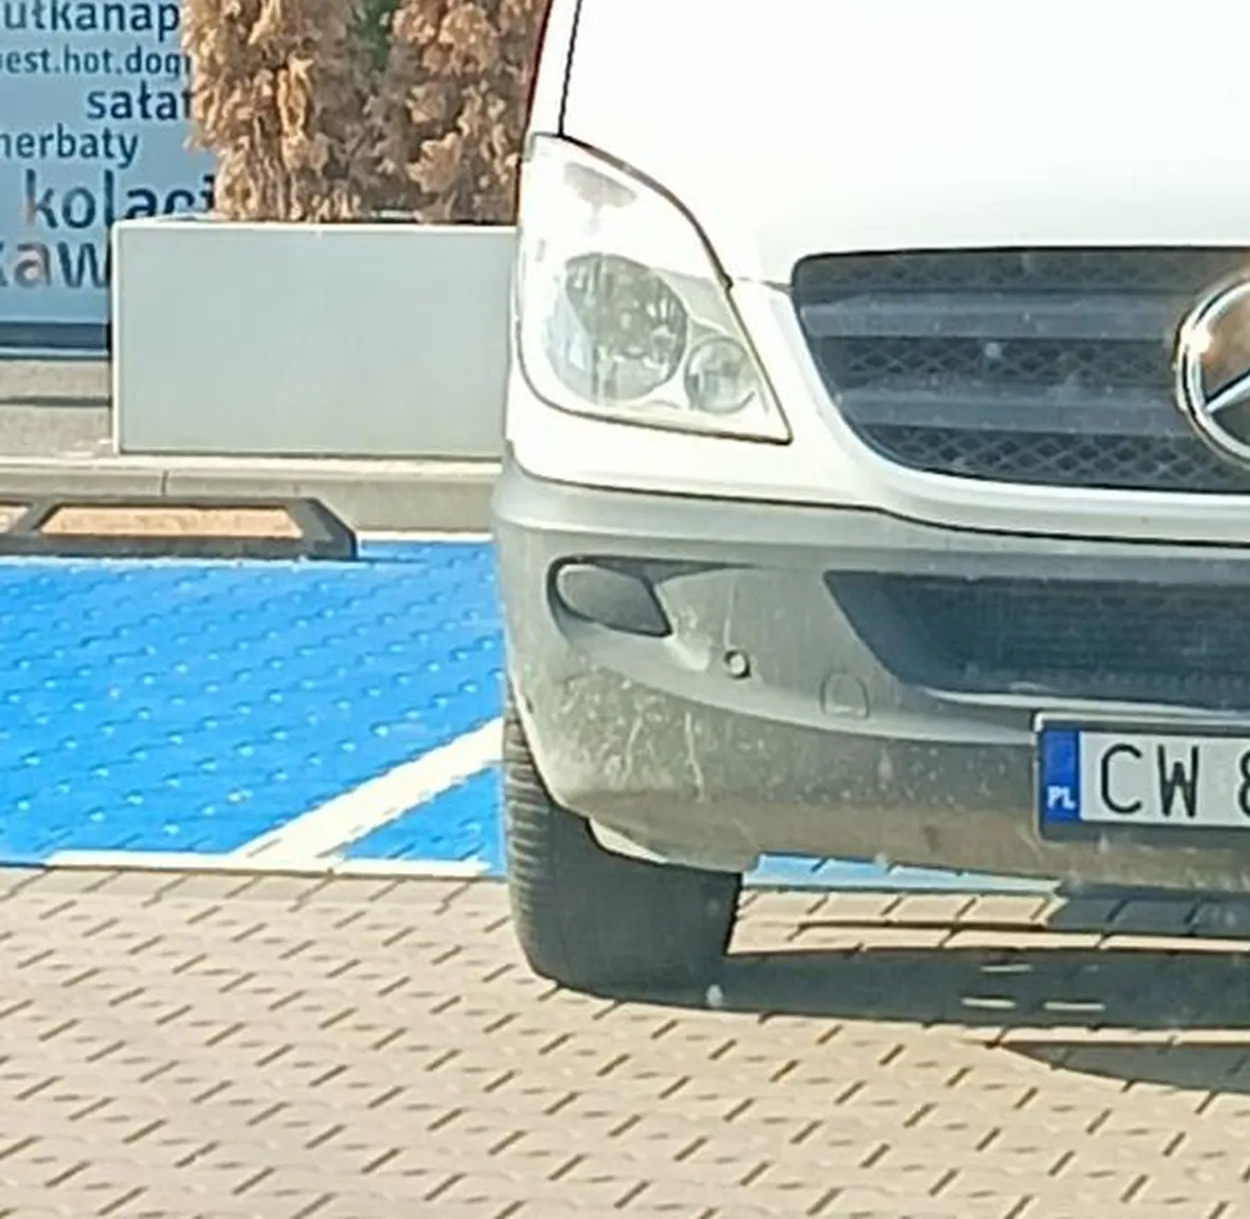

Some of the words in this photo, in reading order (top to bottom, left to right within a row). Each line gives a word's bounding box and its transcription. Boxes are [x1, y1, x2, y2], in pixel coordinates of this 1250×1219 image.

[0, 44, 191, 81] est.hot.dog
[0, 240, 111, 289] aw
[1047, 785, 1076, 810] PL
[1100, 743, 1200, 818] CW
